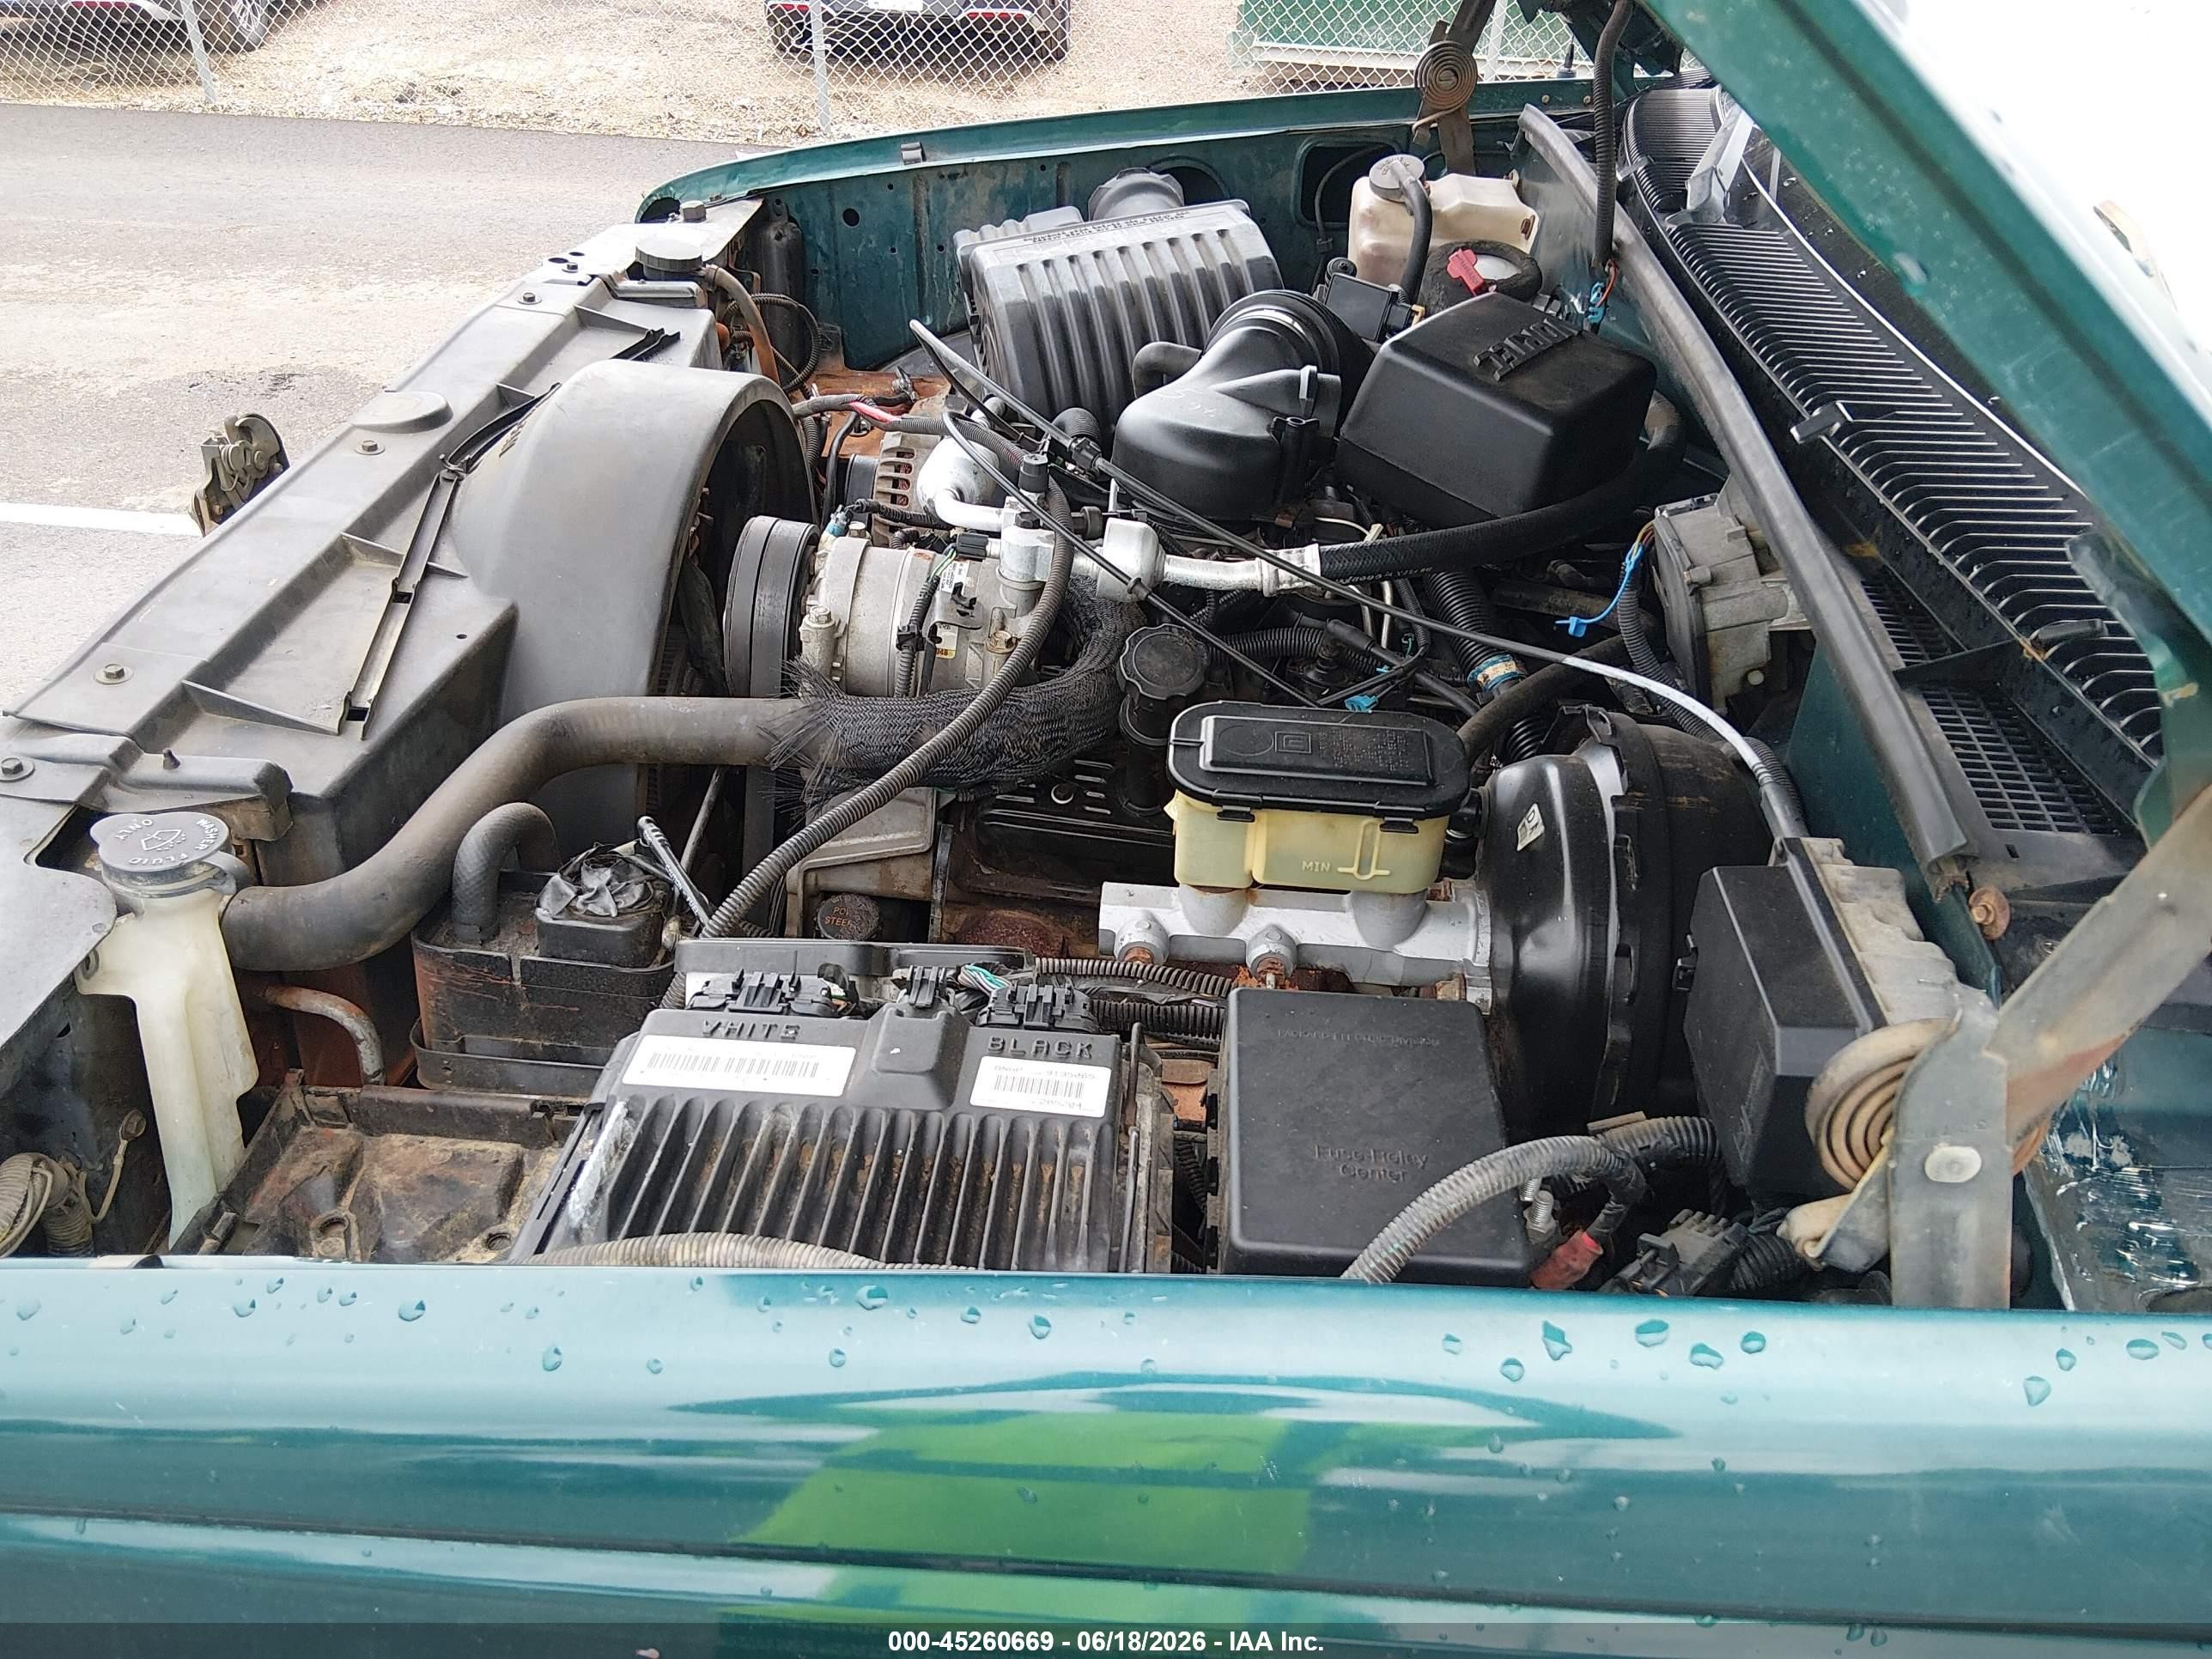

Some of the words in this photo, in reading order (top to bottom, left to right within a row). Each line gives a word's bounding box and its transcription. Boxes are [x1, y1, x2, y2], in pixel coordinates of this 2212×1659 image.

[115, 818, 153, 840] ONLY
[194, 818, 219, 850] WASHER
[129, 852, 189, 866] FLUID
[1302, 860, 1331, 872] MIN
[702, 1019, 800, 1041] WHITE
[988, 1036, 1092, 1059] BLACK
[1340, 1164, 1407, 1182] Center
